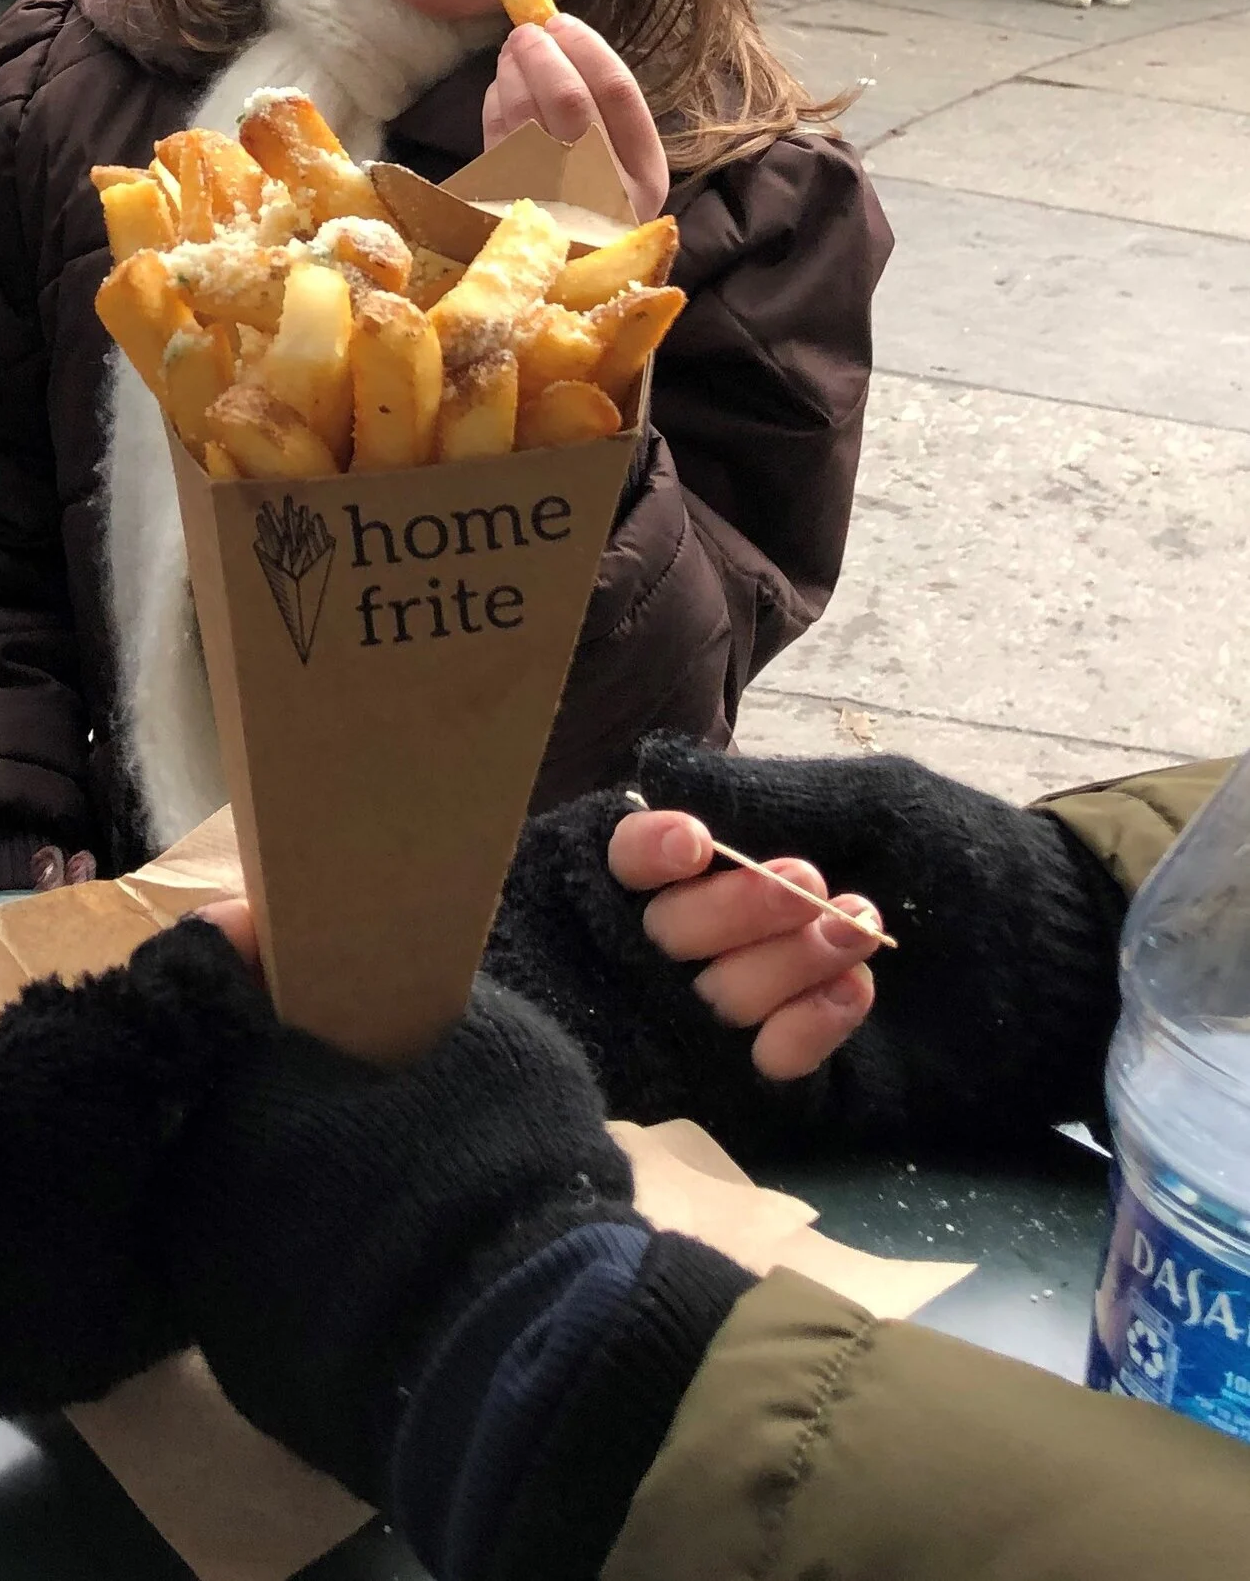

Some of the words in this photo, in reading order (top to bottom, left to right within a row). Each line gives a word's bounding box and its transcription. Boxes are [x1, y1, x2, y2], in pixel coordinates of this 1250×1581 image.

[342, 495, 572, 568] home
[355, 576, 525, 647] frite
[1132, 1228, 1250, 1348] DASA
